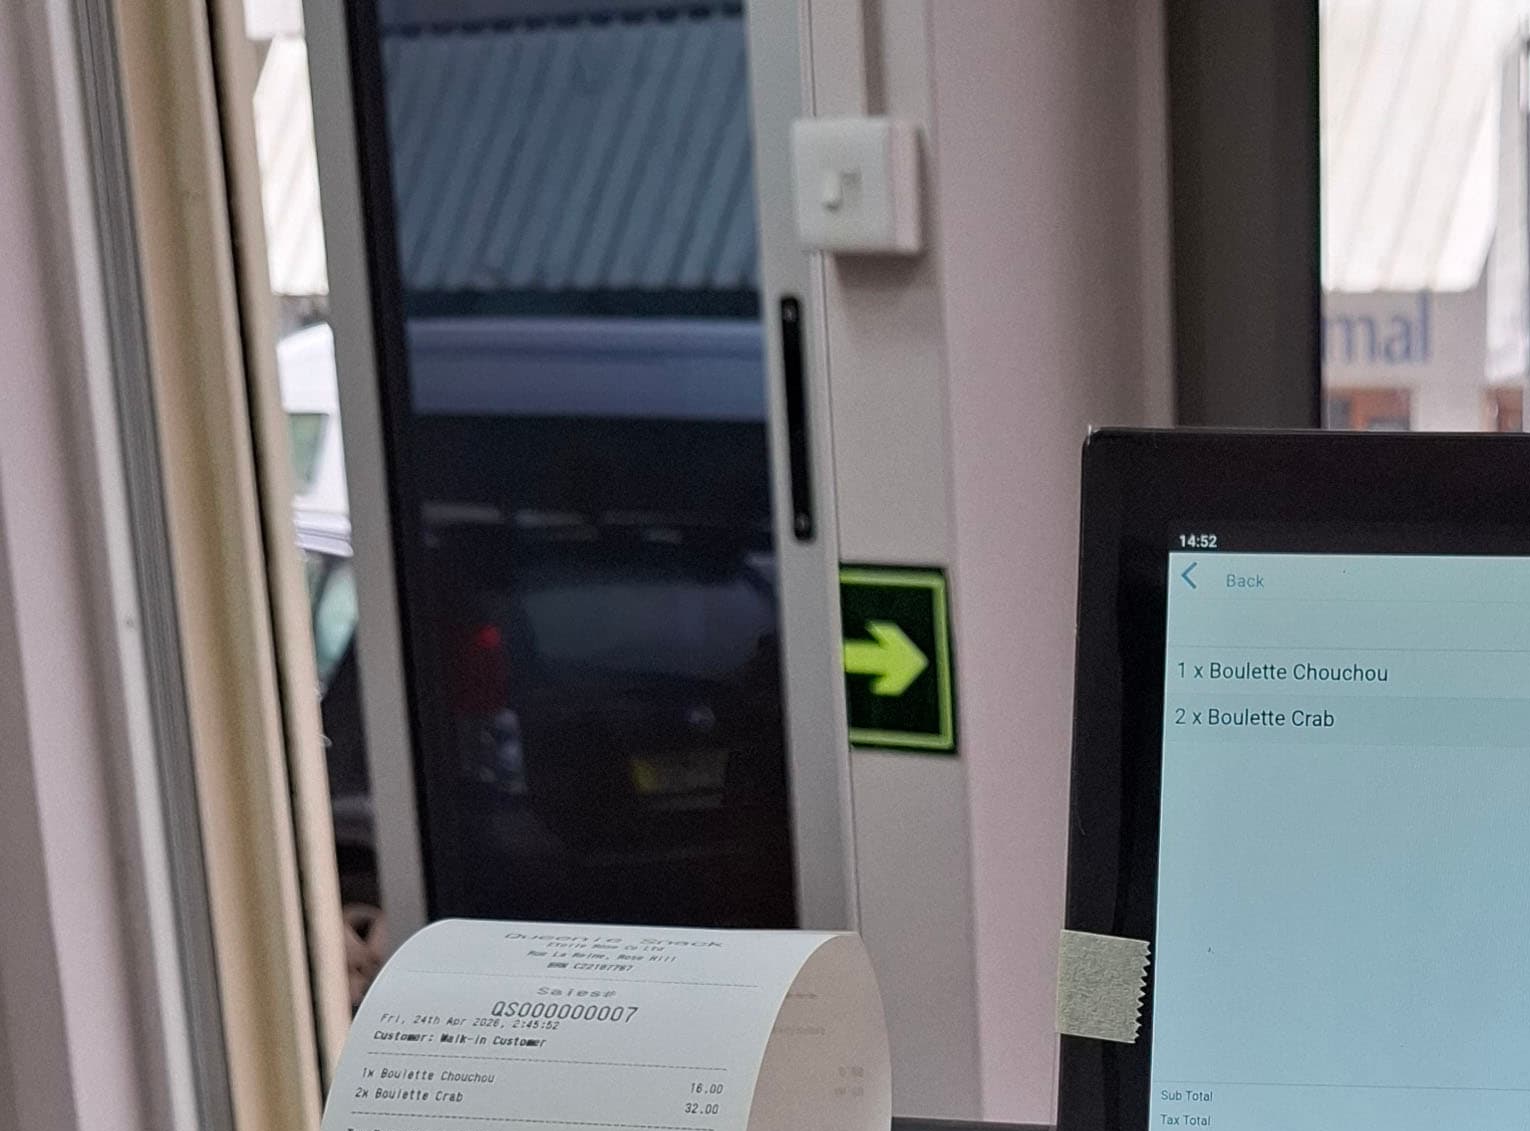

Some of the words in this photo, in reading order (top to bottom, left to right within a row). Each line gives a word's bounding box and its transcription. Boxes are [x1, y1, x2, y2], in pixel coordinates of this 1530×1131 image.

[1179, 534, 1217, 548] 14:52
[1225, 573, 1265, 588] Back
[1177, 662, 1186, 680] 1
[1193, 666, 1203, 680] x
[1209, 661, 1287, 682] Boulette
[1293, 661, 1389, 683] Chouchou
[1175, 708, 1186, 726] 2
[1191, 712, 1202, 726] x
[1207, 706, 1285, 728] Boulette
[1291, 707, 1335, 729] Crab
[649, 955, 677, 963] Hill
[491, 1001, 639, 1023] QS000000007
[413, 1014, 441, 1025] 24th
[446, 1016, 467, 1027] Apr
[512, 1019, 560, 1031] 2:45:52
[373, 1030, 434, 1042] Customer:
[440, 1032, 487, 1046] Walk-in
[492, 1036, 547, 1048] Customer
[362, 1067, 374, 1078] 1x
[380, 1067, 434, 1081] Boulette
[440, 1070, 495, 1084] Chouchou
[354, 1086, 369, 1098] 2x
[375, 1087, 429, 1101] Boulette
[435, 1089, 464, 1103] Crab
[690, 1082, 723, 1094] 16.00
[1160, 1089, 1182, 1102] Sub
[1185, 1090, 1213, 1103] Total
[684, 1102, 719, 1115] 32.00
[1160, 1114, 1180, 1126] Tax
[1183, 1114, 1211, 1127] Total
